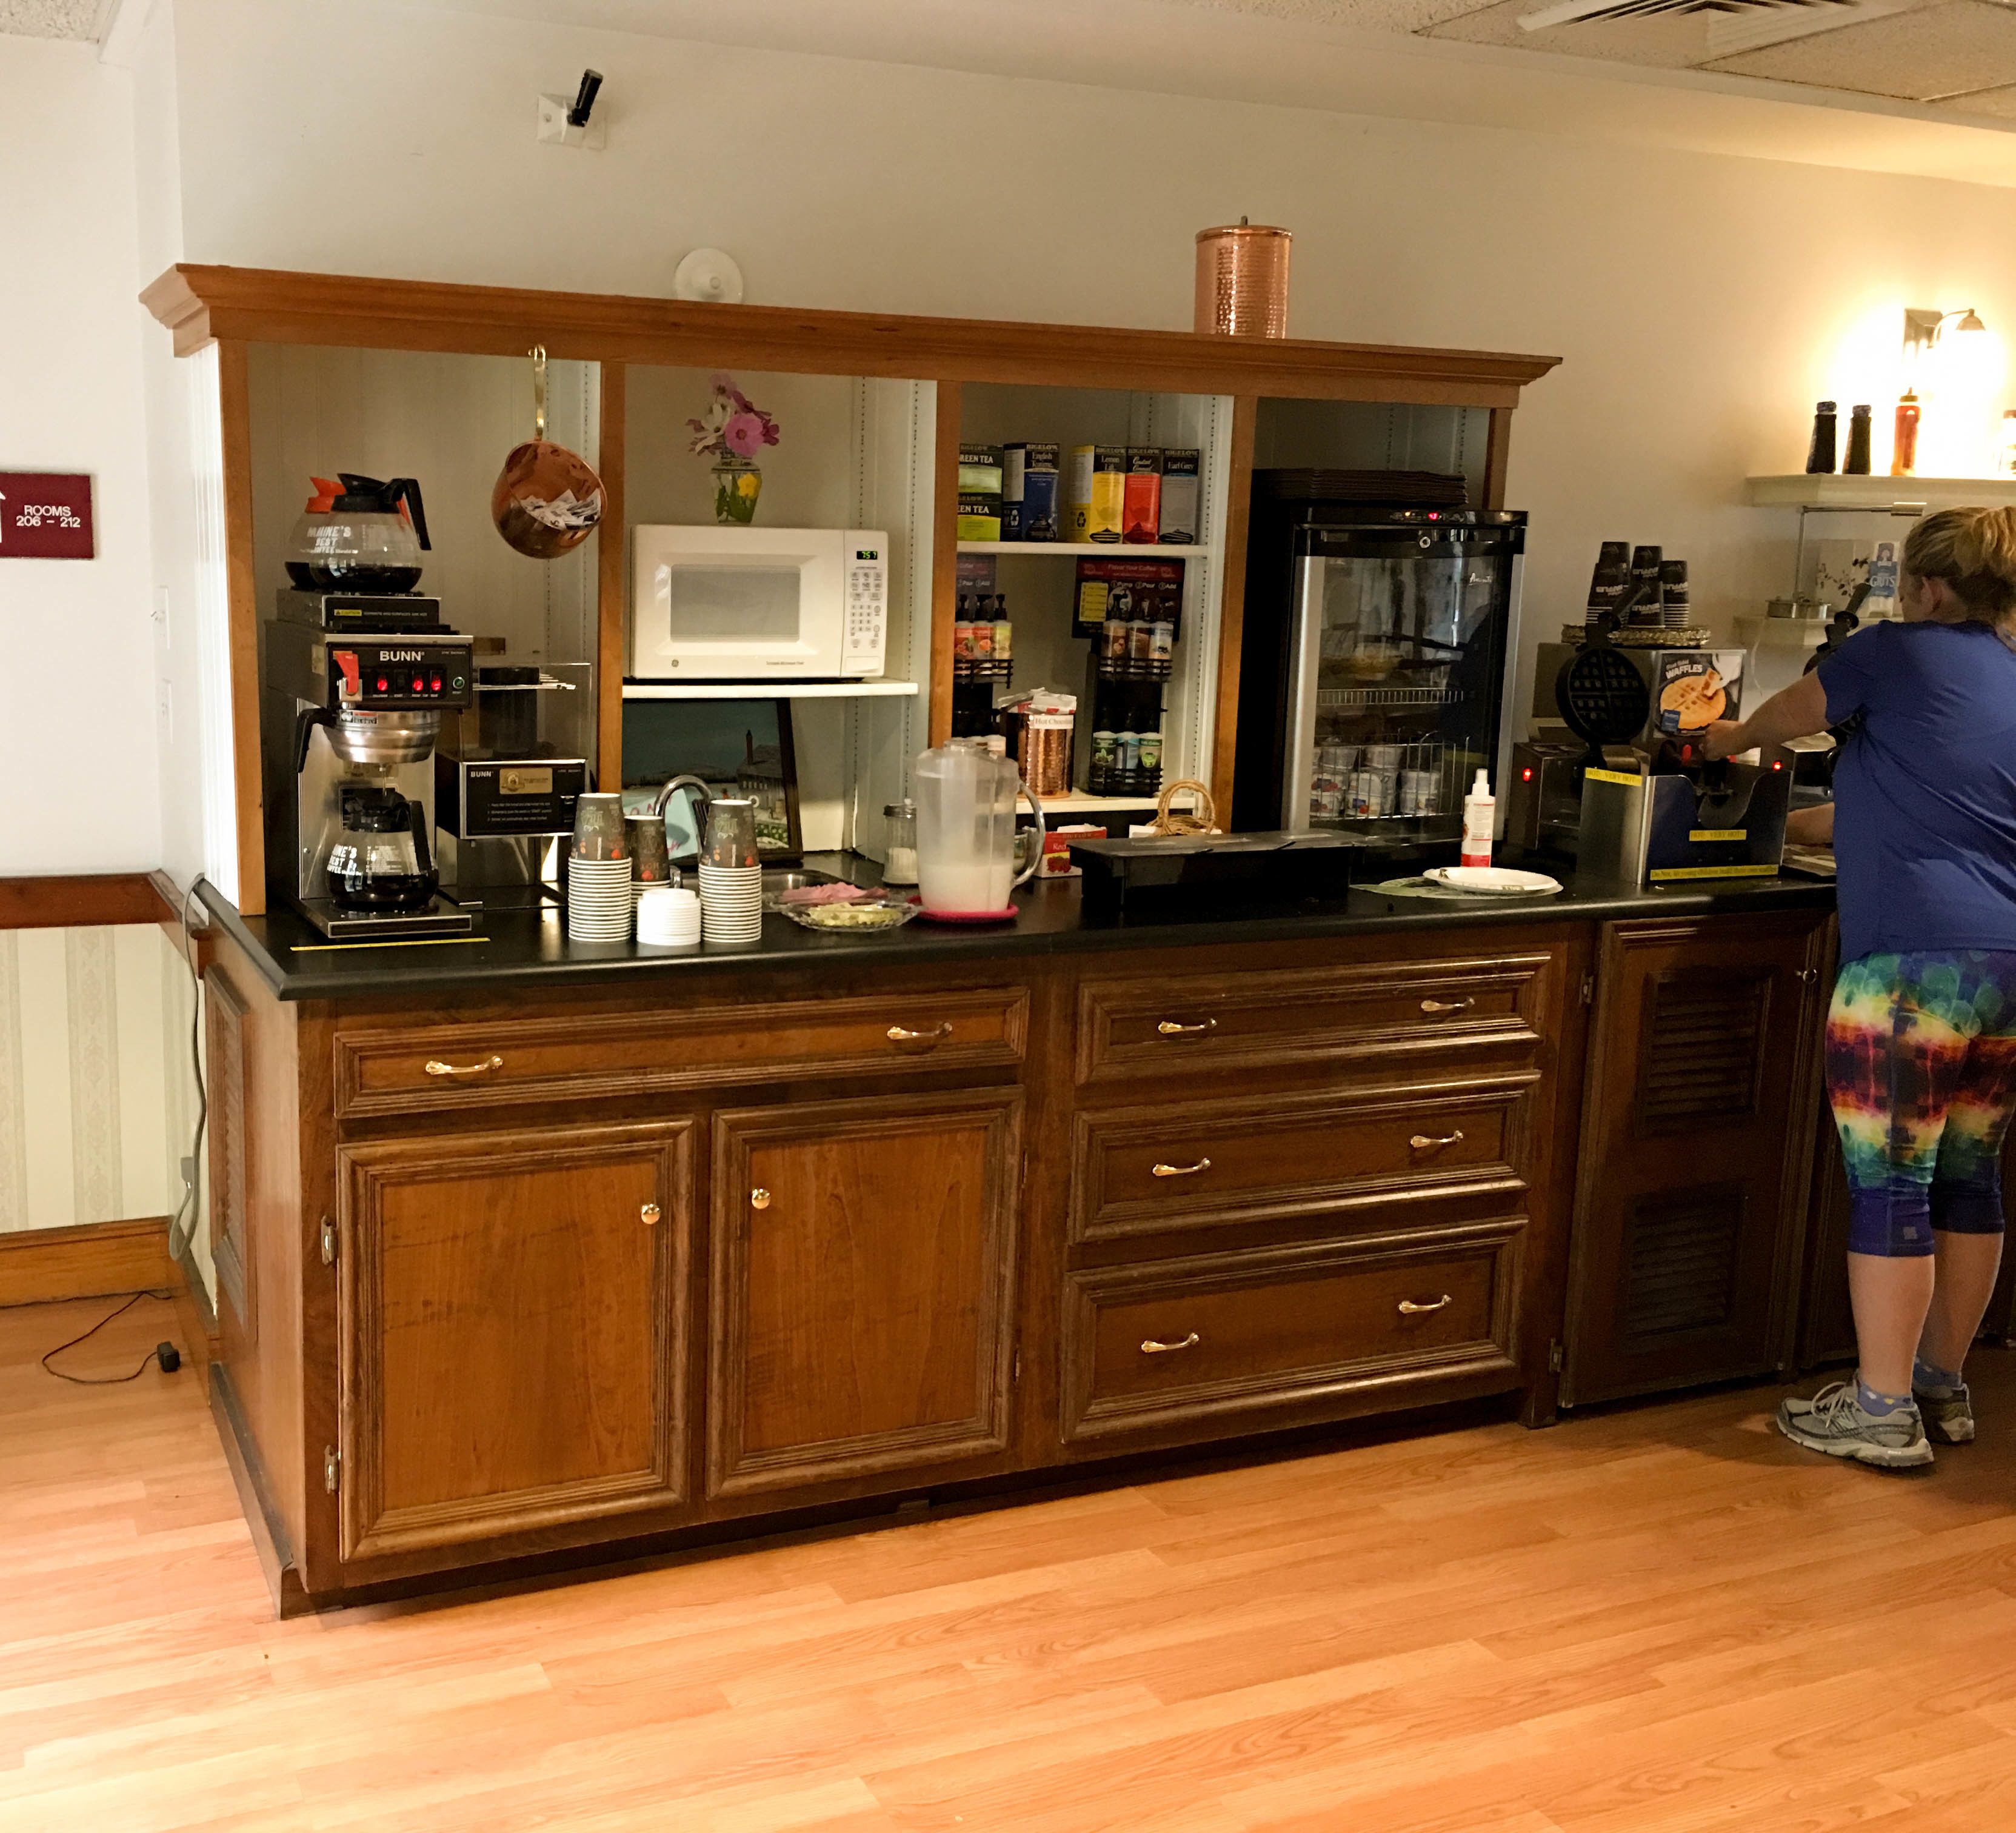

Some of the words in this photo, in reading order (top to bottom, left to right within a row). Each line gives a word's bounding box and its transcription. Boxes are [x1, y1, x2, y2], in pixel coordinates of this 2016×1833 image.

[24, 505, 72, 516] ROOMS
[16, 515, 41, 527] 206
[60, 516, 81, 528] 212
[379, 650, 421, 661] BUNN
[1666, 664, 1703, 679] WAFFLES
